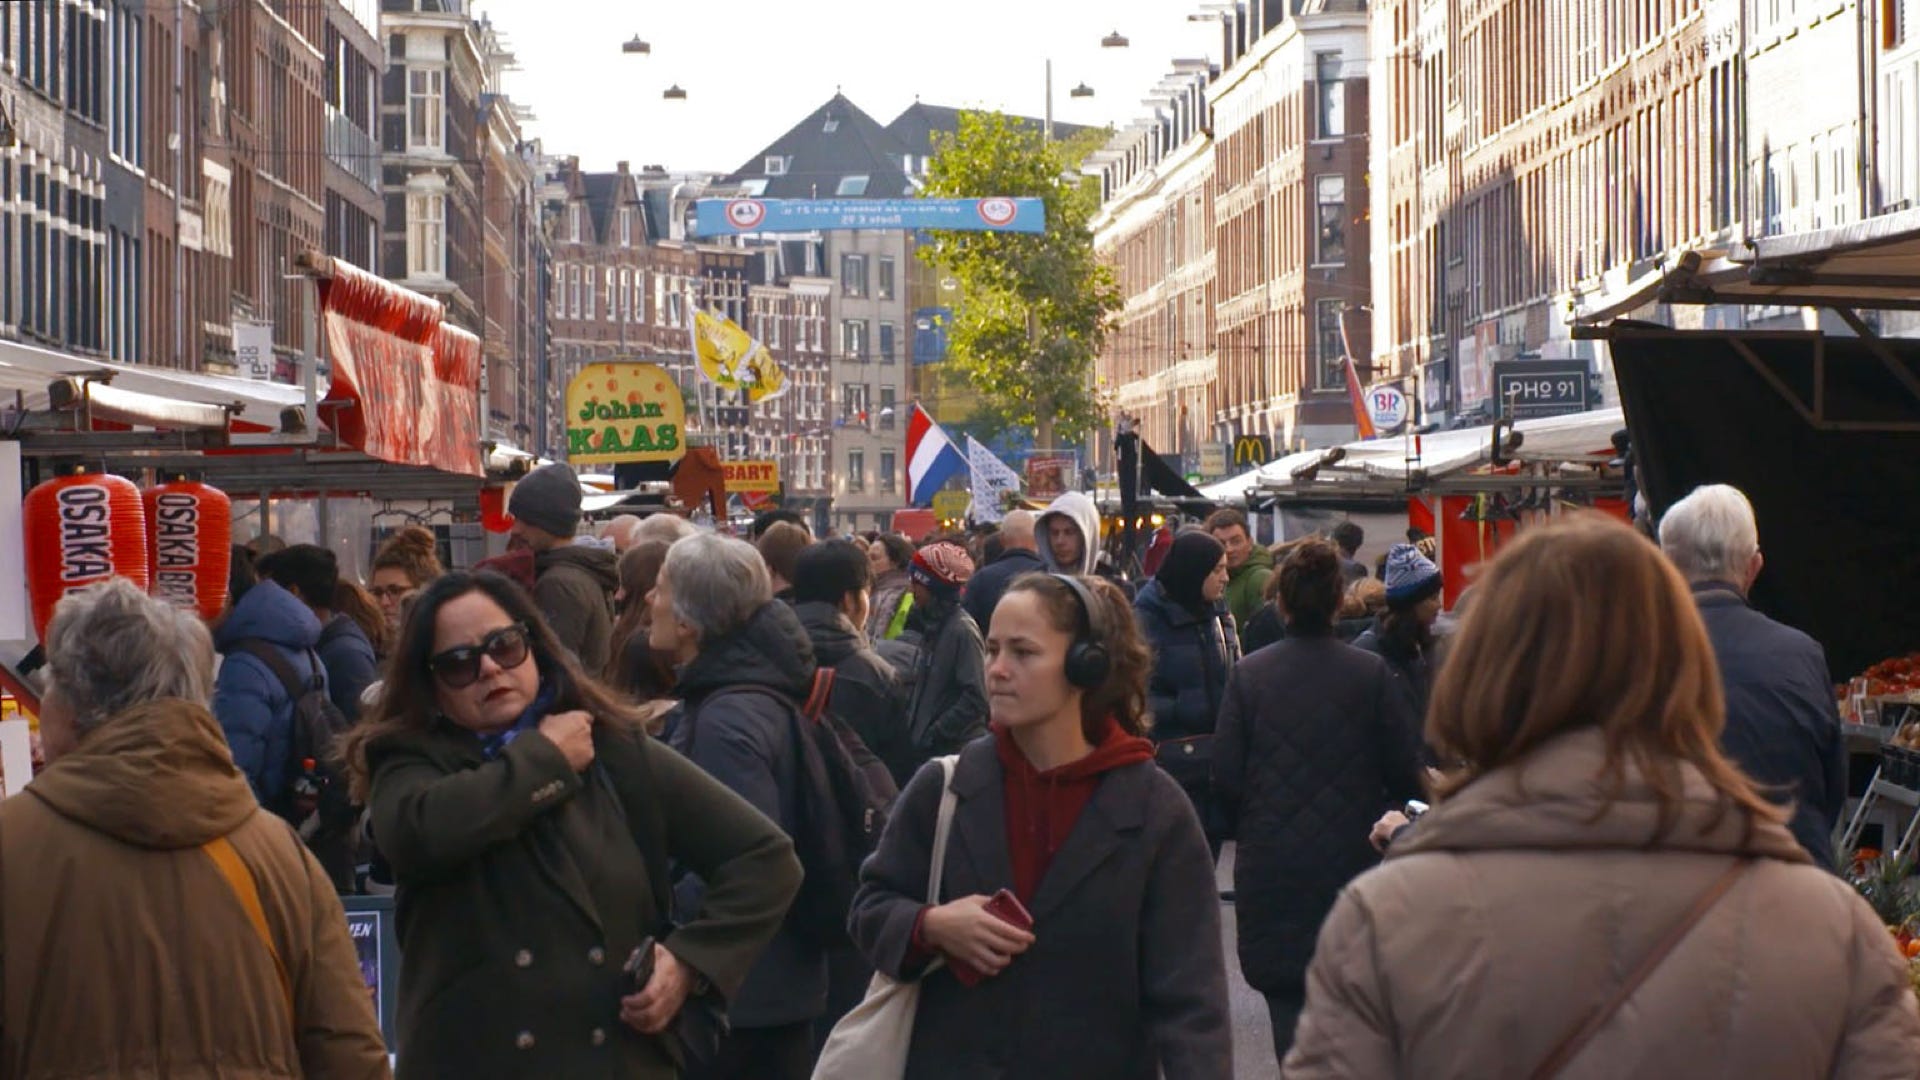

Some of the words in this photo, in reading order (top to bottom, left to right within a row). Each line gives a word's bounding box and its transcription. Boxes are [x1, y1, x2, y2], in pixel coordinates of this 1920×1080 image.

[1557, 381, 1575, 398] 91
[580, 400, 664, 420] Johan
[1373, 393, 1400, 411] BR
[567, 424, 680, 454] KAAS
[724, 465, 773, 480] BART
[58, 486, 113, 581] OSAKA
[156, 493, 198, 568] OSAKA
